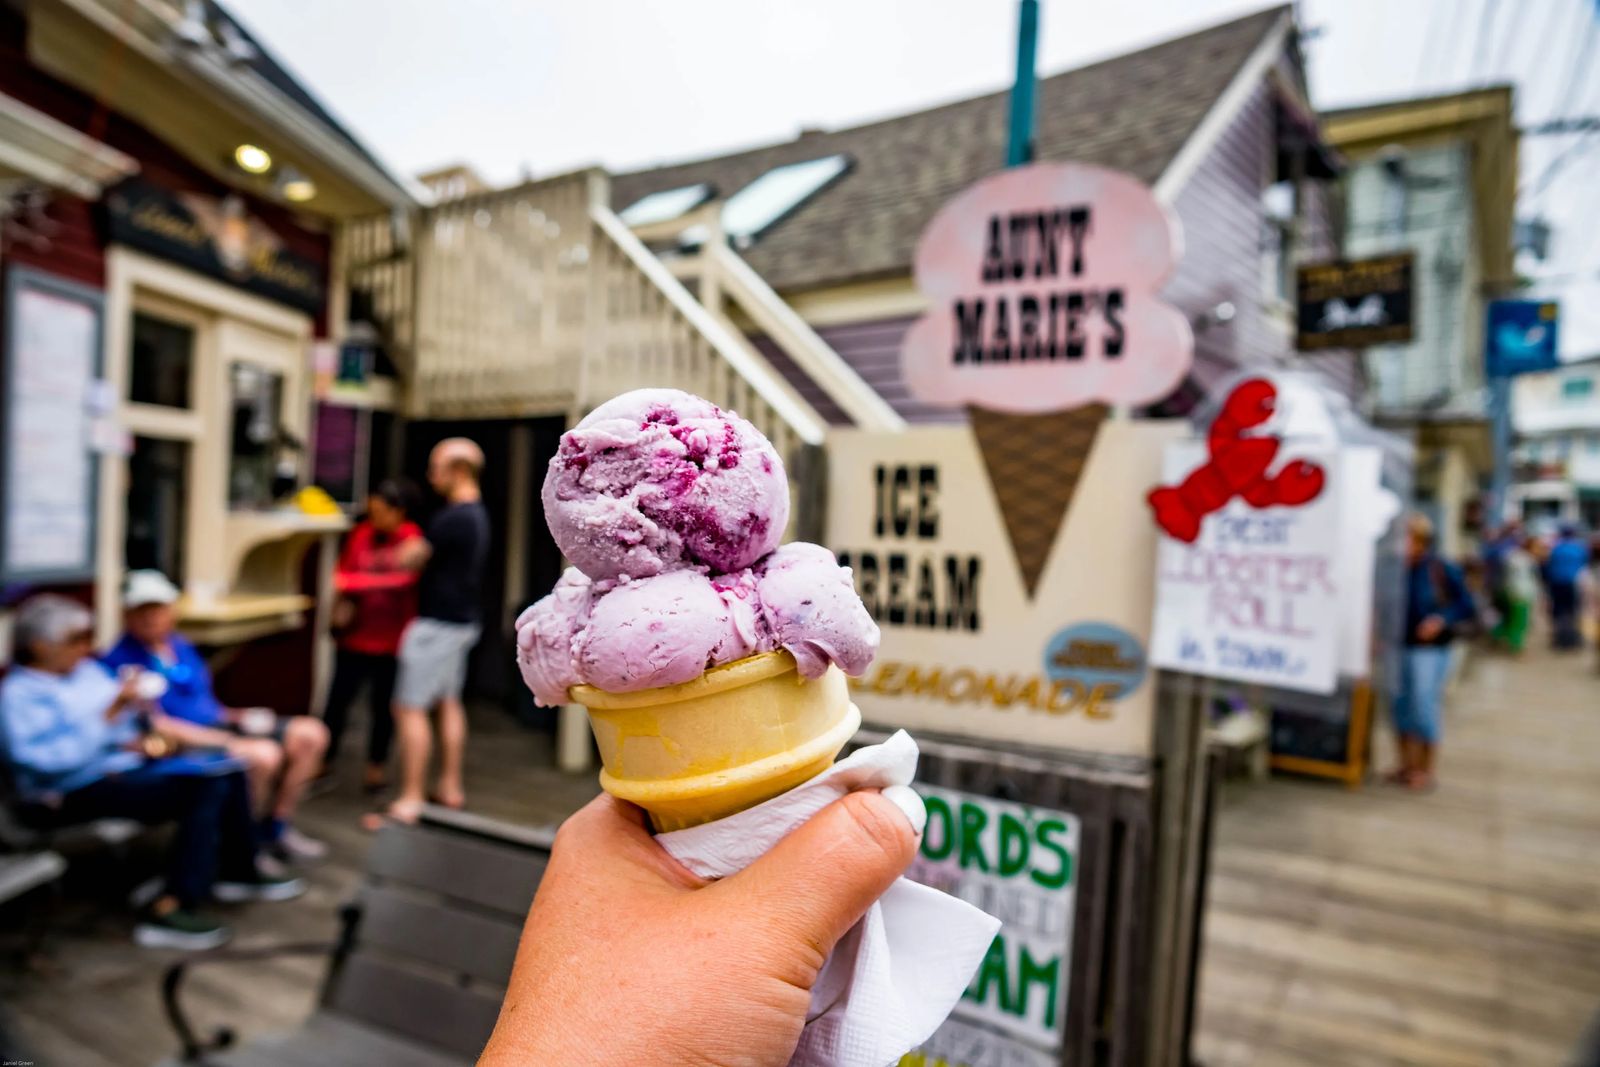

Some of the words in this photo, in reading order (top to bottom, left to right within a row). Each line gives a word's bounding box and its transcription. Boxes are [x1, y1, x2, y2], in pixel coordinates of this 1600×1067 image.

[982, 205, 1092, 282] AUNT
[952, 287, 1125, 365] MARIE'S
[874, 464, 939, 540] ICE
[838, 552, 982, 633] REAM
[919, 795, 1075, 890] ORD'S
[961, 933, 1061, 1031] AM
